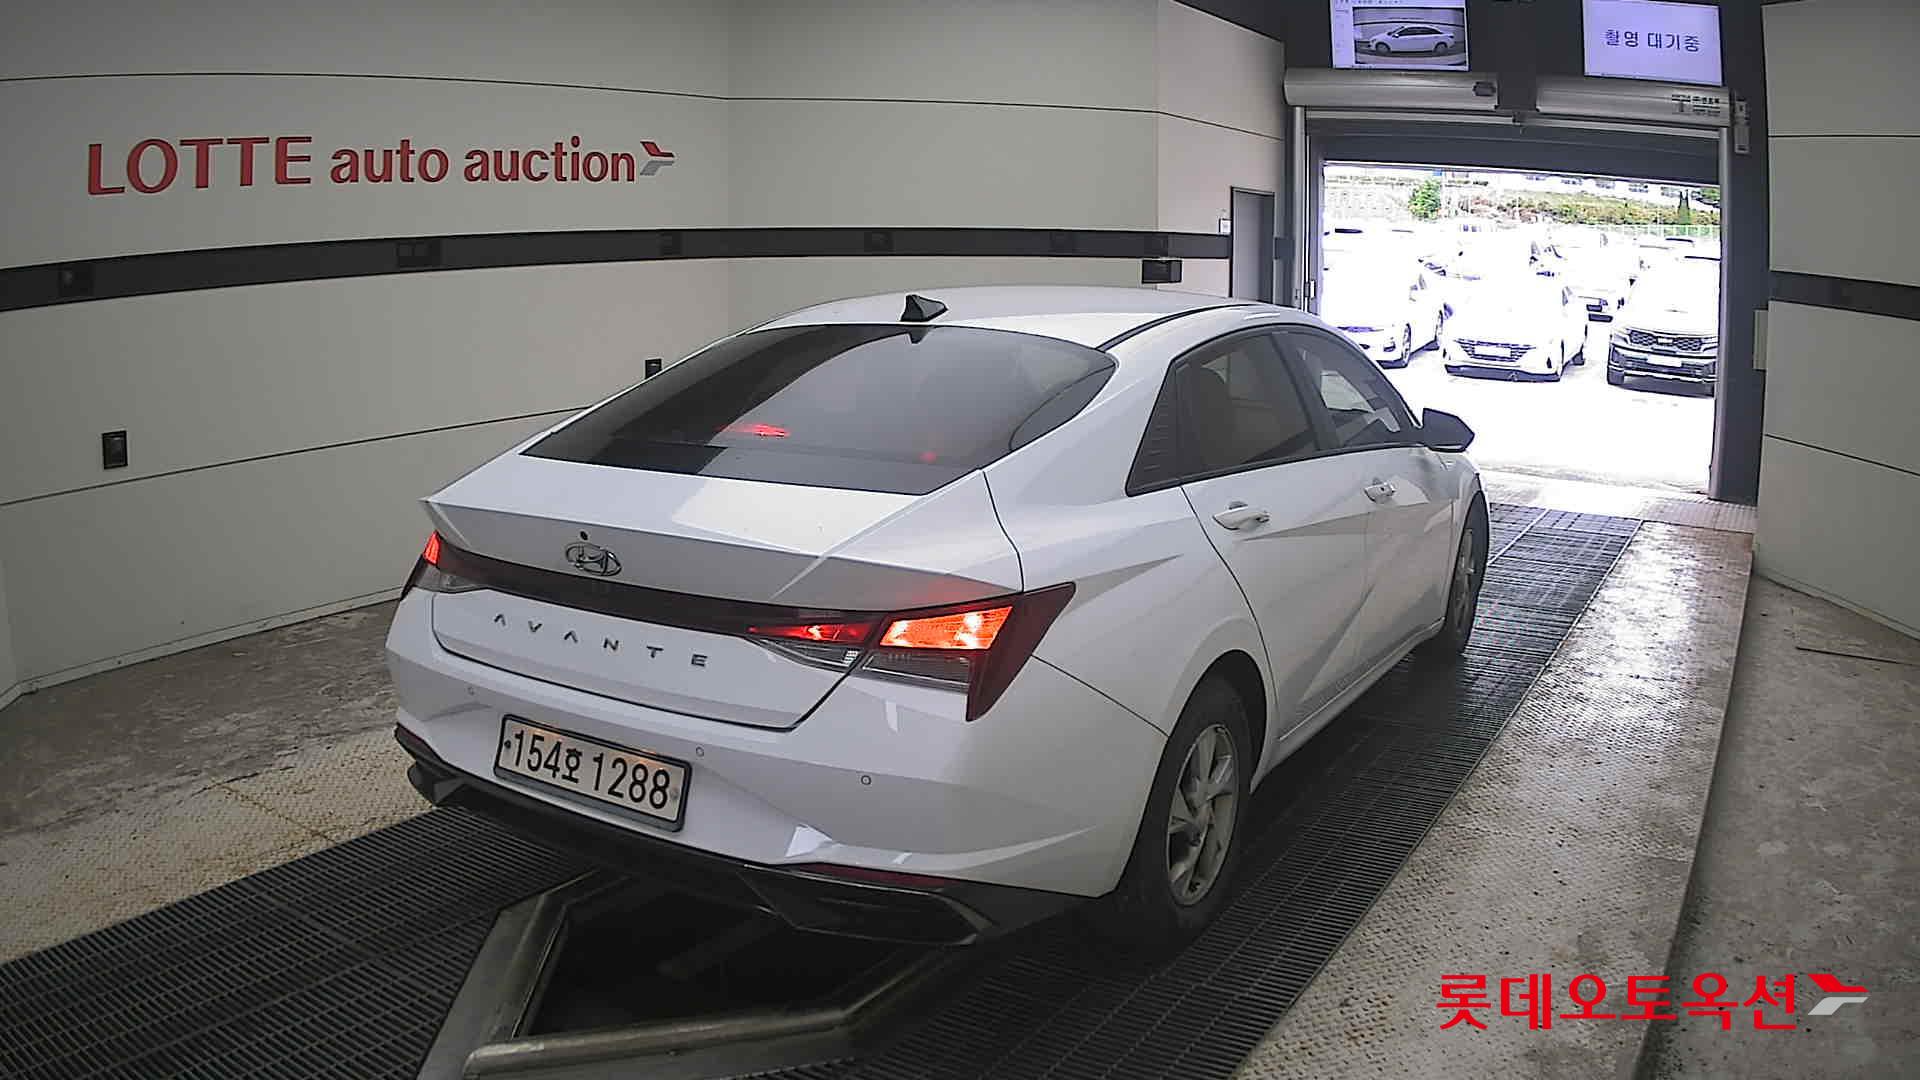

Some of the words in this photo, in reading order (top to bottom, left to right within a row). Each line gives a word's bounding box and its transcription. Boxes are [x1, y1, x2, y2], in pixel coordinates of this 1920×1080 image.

[1647, 32, 1700, 52] 대기중
[88, 136, 313, 195] LOTTE
[330, 139, 450, 184] auto
[464, 136, 636, 184] auction
[493, 613, 708, 667] AVANTE
[513, 730, 582, 783] 154호
[592, 753, 671, 809] 1288
